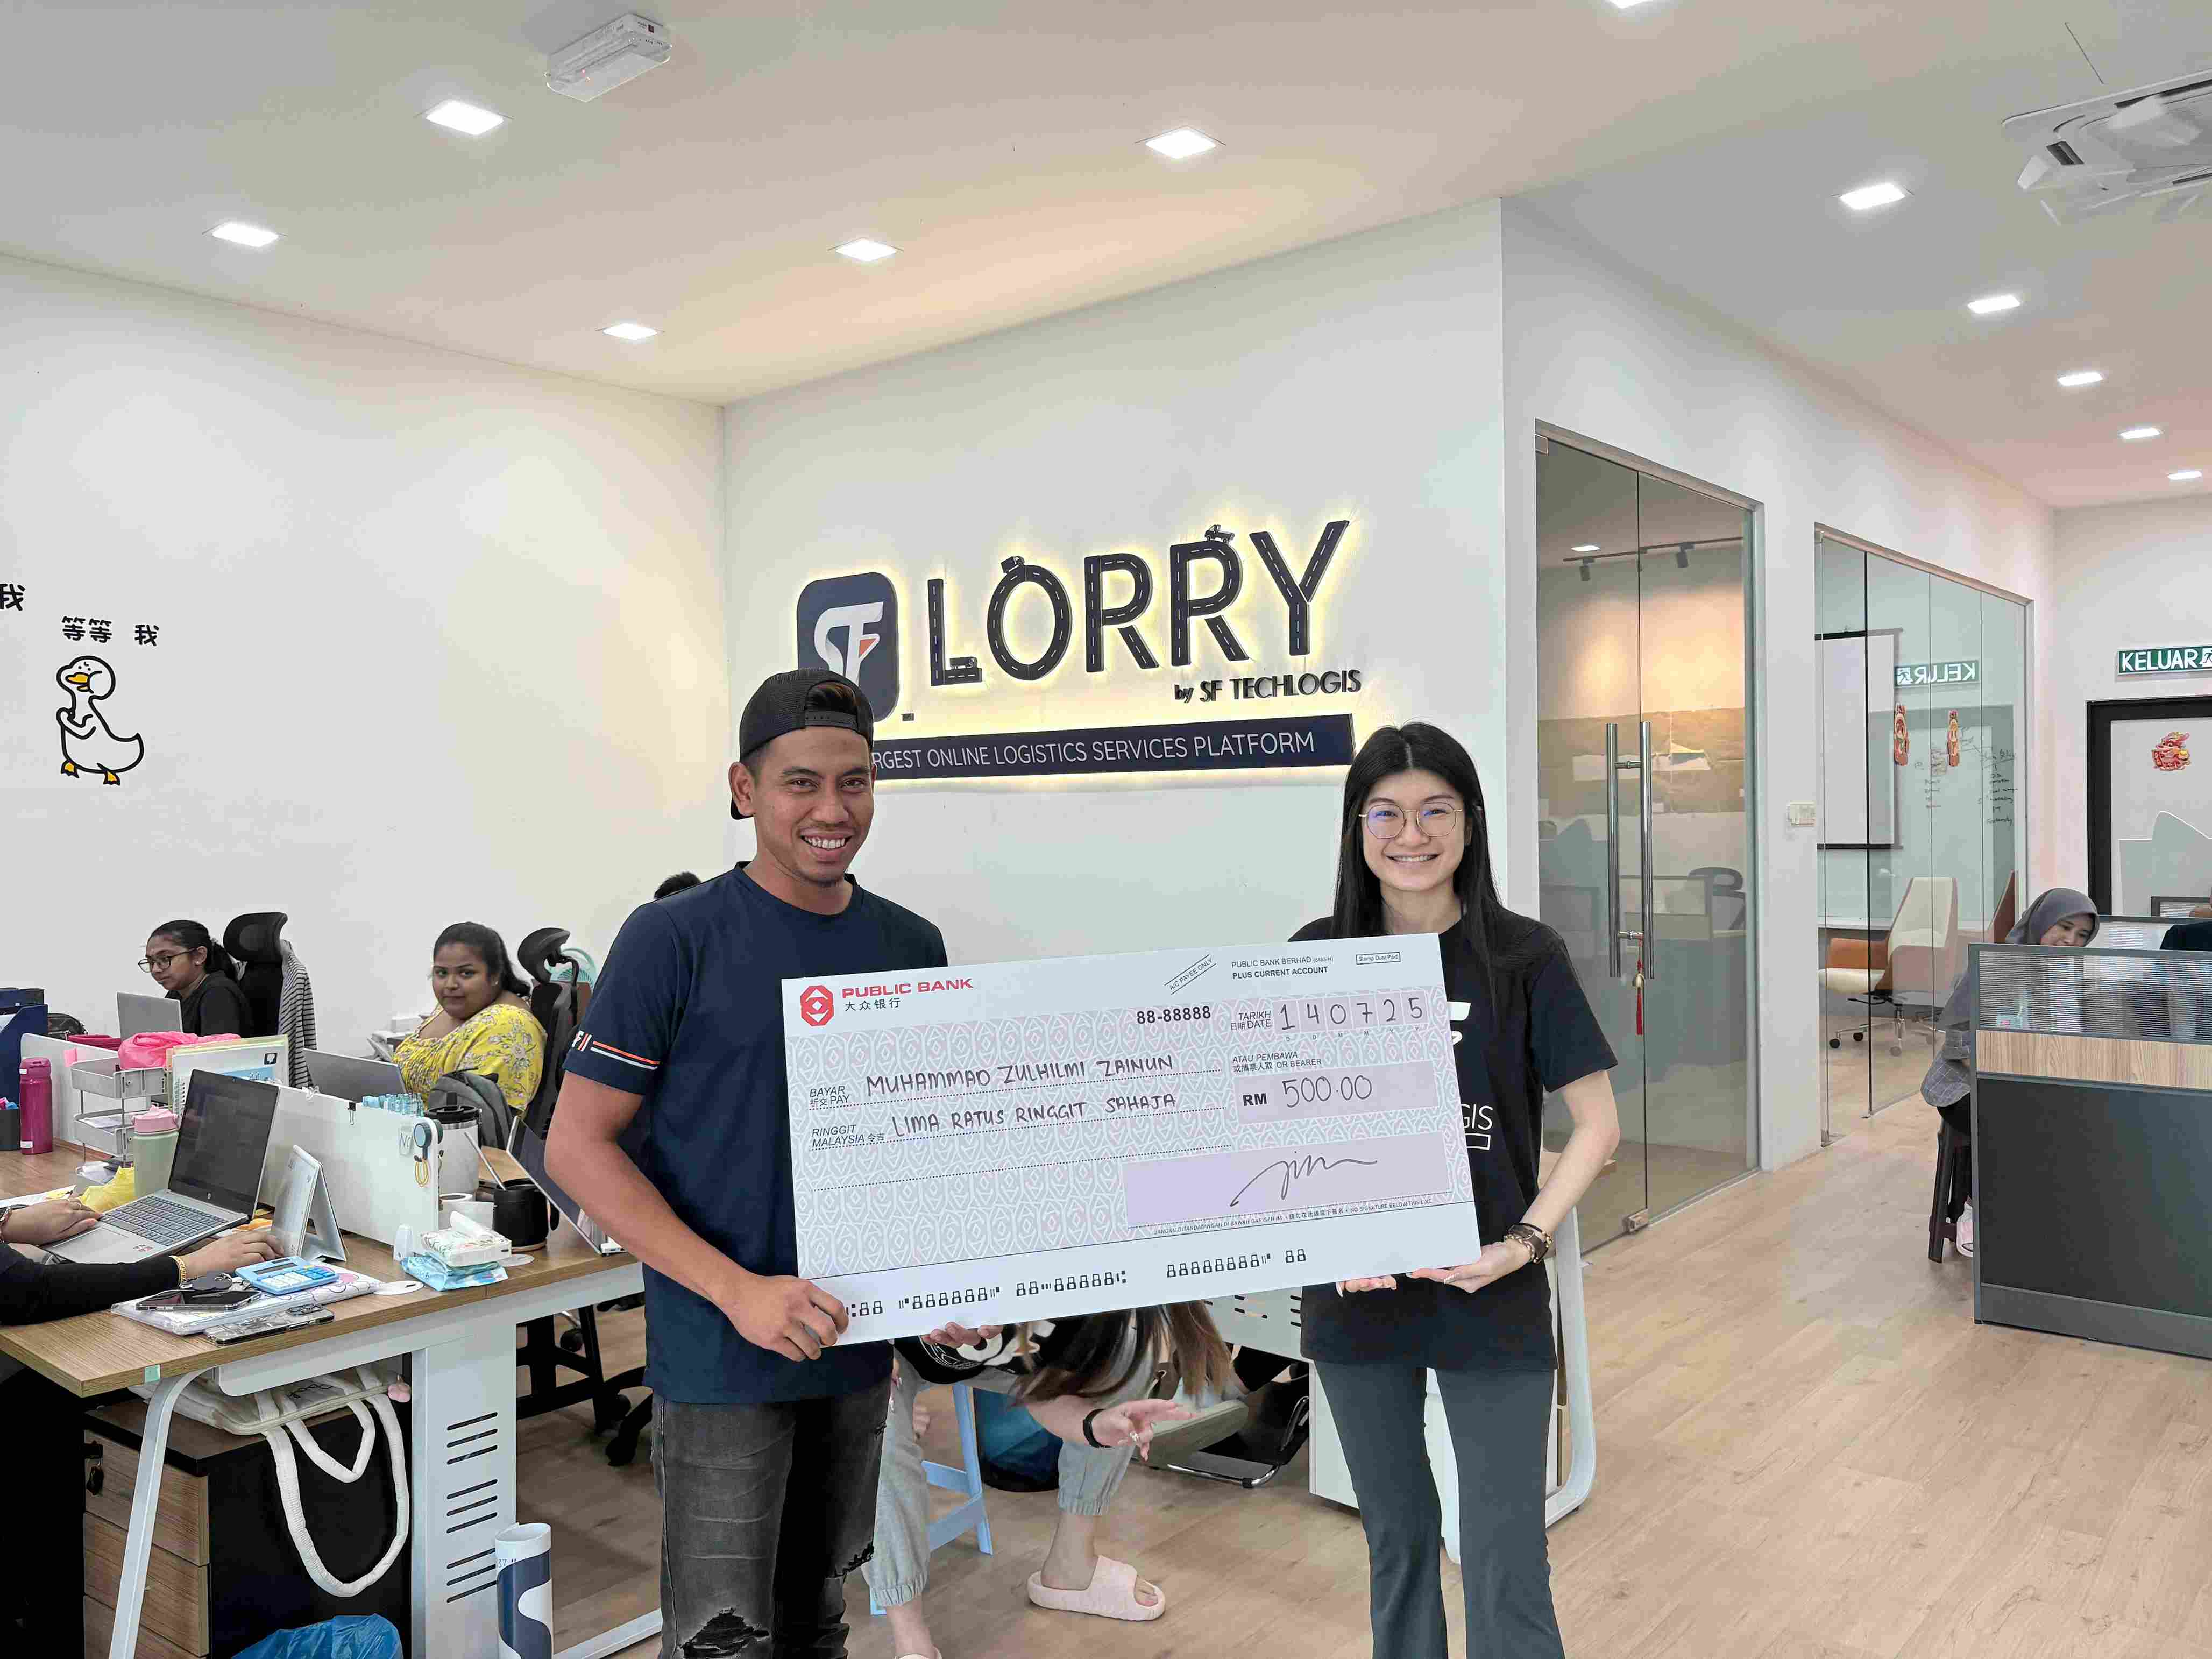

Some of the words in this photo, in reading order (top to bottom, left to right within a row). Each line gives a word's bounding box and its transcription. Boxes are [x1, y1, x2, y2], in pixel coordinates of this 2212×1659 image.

[0, 584, 25, 611] 我
[927, 520, 1350, 686] LORRY
[61, 616, 112, 643] 等等
[134, 625, 159, 646] 我
[2122, 649, 2200, 671] KELUAR
[1174, 684, 1194, 703] by
[1200, 679, 1222, 702] SF
[1230, 669, 1362, 699] TECHLOGIS
[873, 749, 921, 769] RGEST
[927, 746, 990, 768] ONLINE
[995, 742, 1087, 765] LOGISTICS
[1091, 737, 1187, 761] SERVICES
[1194, 731, 1314, 757] PLATFORM
[1179, 968, 1198, 983] PAYEE
[1197, 956, 1214, 970] ONLY
[1231, 960, 1258, 968] PUBLIC
[1260, 958, 1280, 966] BANK
[1282, 956, 1311, 965] BERHAD
[1232, 972, 1253, 980] PLUS
[1254, 969, 1290, 978] CURRENT
[1292, 966, 1328, 975] ACCOUNT
[842, 983, 912, 999] PUBLIC
[917, 978, 973, 993] BANK
[845, 998, 901, 1012] 大众银行
[1137, 1006, 1210, 1024] 88-88888
[1239, 1011, 1271, 1021] TARIKH
[1247, 1019, 1273, 1029] DATE
[1232, 1055, 1254, 1064] ATAU
[1256, 1052, 1298, 1062] PEMBAWA
[1277, 1061, 1288, 1069] OR
[1291, 1058, 1322, 1067] BEARER
[866, 1069, 991, 1097] MUHAMMAD
[997, 1061, 1086, 1084] ZULHILMI
[1096, 1055, 1173, 1077] ZAINUN
[810, 1086, 846, 1098] BAYAR
[830, 1094, 850, 1104] PAY
[1242, 1093, 1267, 1107] RM
[1282, 1075, 1372, 1108] 500.00
[891, 1113, 940, 1137] LIMA
[951, 1109, 1004, 1130] RATUS
[1016, 1102, 1087, 1122] RINGGIT
[1105, 1093, 1176, 1114] SAHAJA
[812, 1124, 857, 1138] RINGGIT
[812, 1133, 865, 1148] MALAYSIA
[1154, 1227, 1177, 1235] JANGAN
[1359, 1203, 1388, 1211] SIGNATURE
